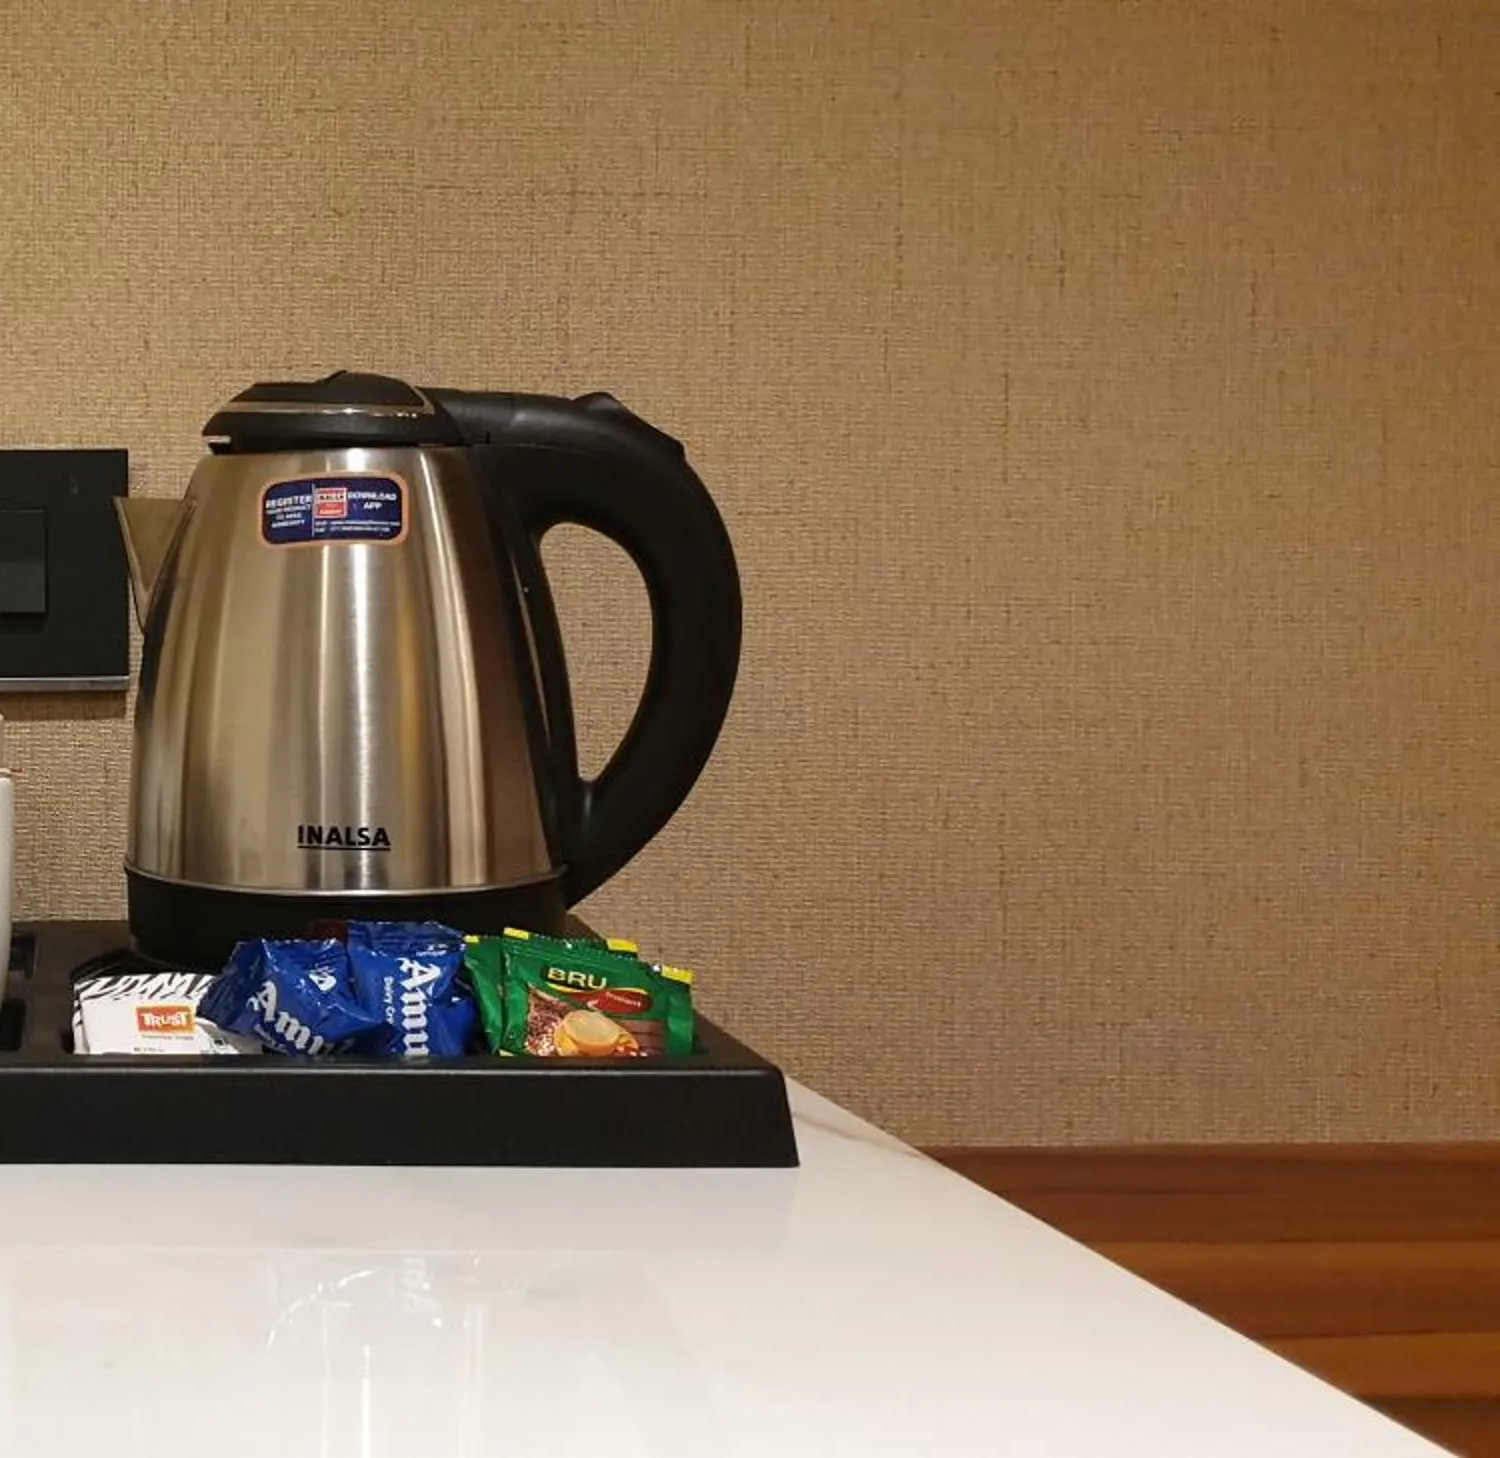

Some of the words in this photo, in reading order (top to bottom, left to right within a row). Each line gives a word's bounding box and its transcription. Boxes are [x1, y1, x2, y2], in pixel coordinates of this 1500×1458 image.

[265, 494, 312, 509] REGISTER
[347, 491, 397, 501] DOWNLOAD
[363, 501, 382, 510] APP
[297, 825, 391, 847] INALSA
[547, 967, 607, 990] BRU
[395, 957, 441, 1057] Amu
